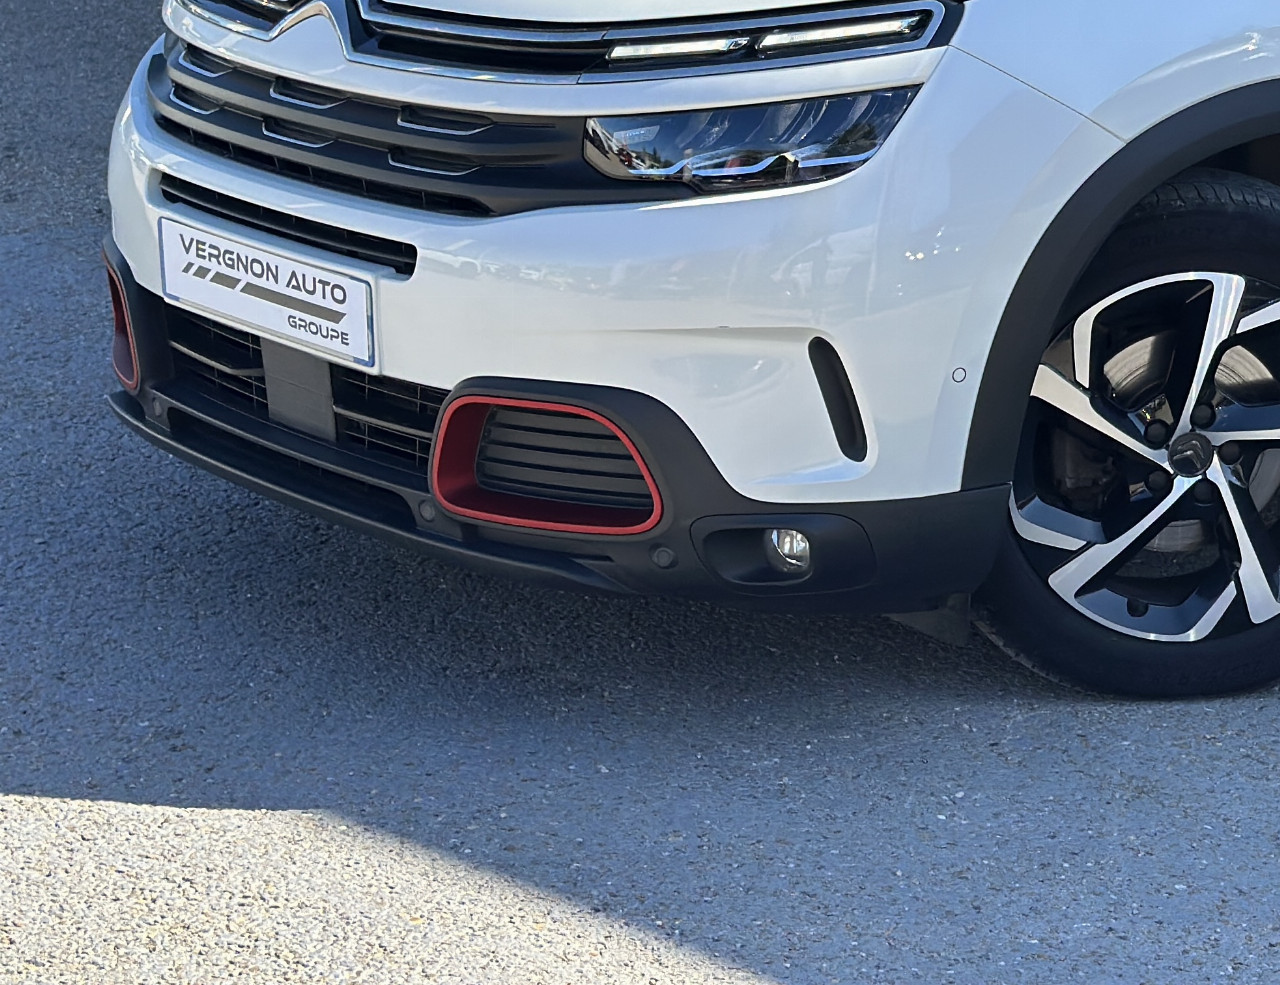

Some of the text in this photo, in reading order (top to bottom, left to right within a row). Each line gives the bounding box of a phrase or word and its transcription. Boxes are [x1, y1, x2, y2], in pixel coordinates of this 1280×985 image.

[179, 233, 347, 305] VERGNON AUTO
[287, 314, 350, 346] GROUPE
